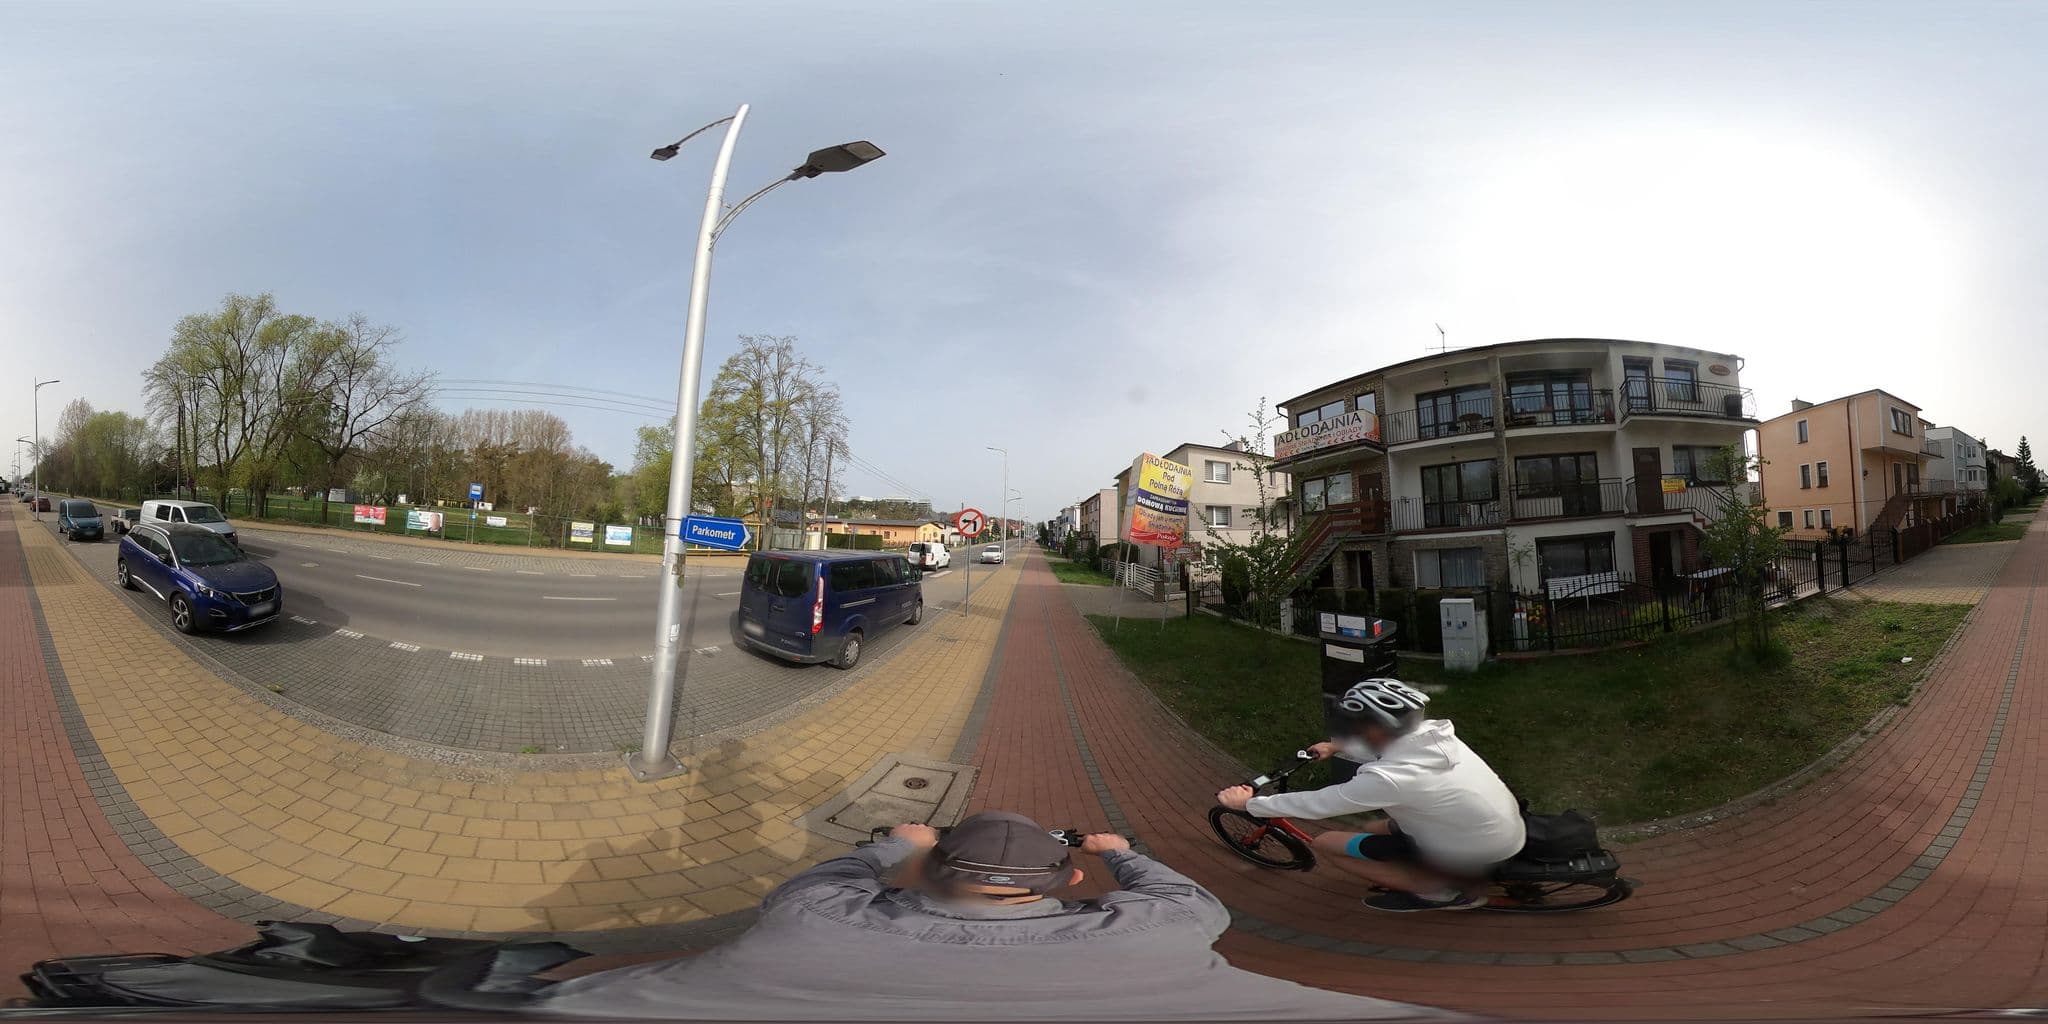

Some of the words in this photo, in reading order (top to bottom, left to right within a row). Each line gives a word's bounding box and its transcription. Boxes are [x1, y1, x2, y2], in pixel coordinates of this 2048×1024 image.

[1163, 472, 1175, 482] Pod
[1149, 479, 1168, 493] Polną
[1137, 496, 1164, 511] DOMOWĄ
[692, 525, 736, 540] Parkometr
